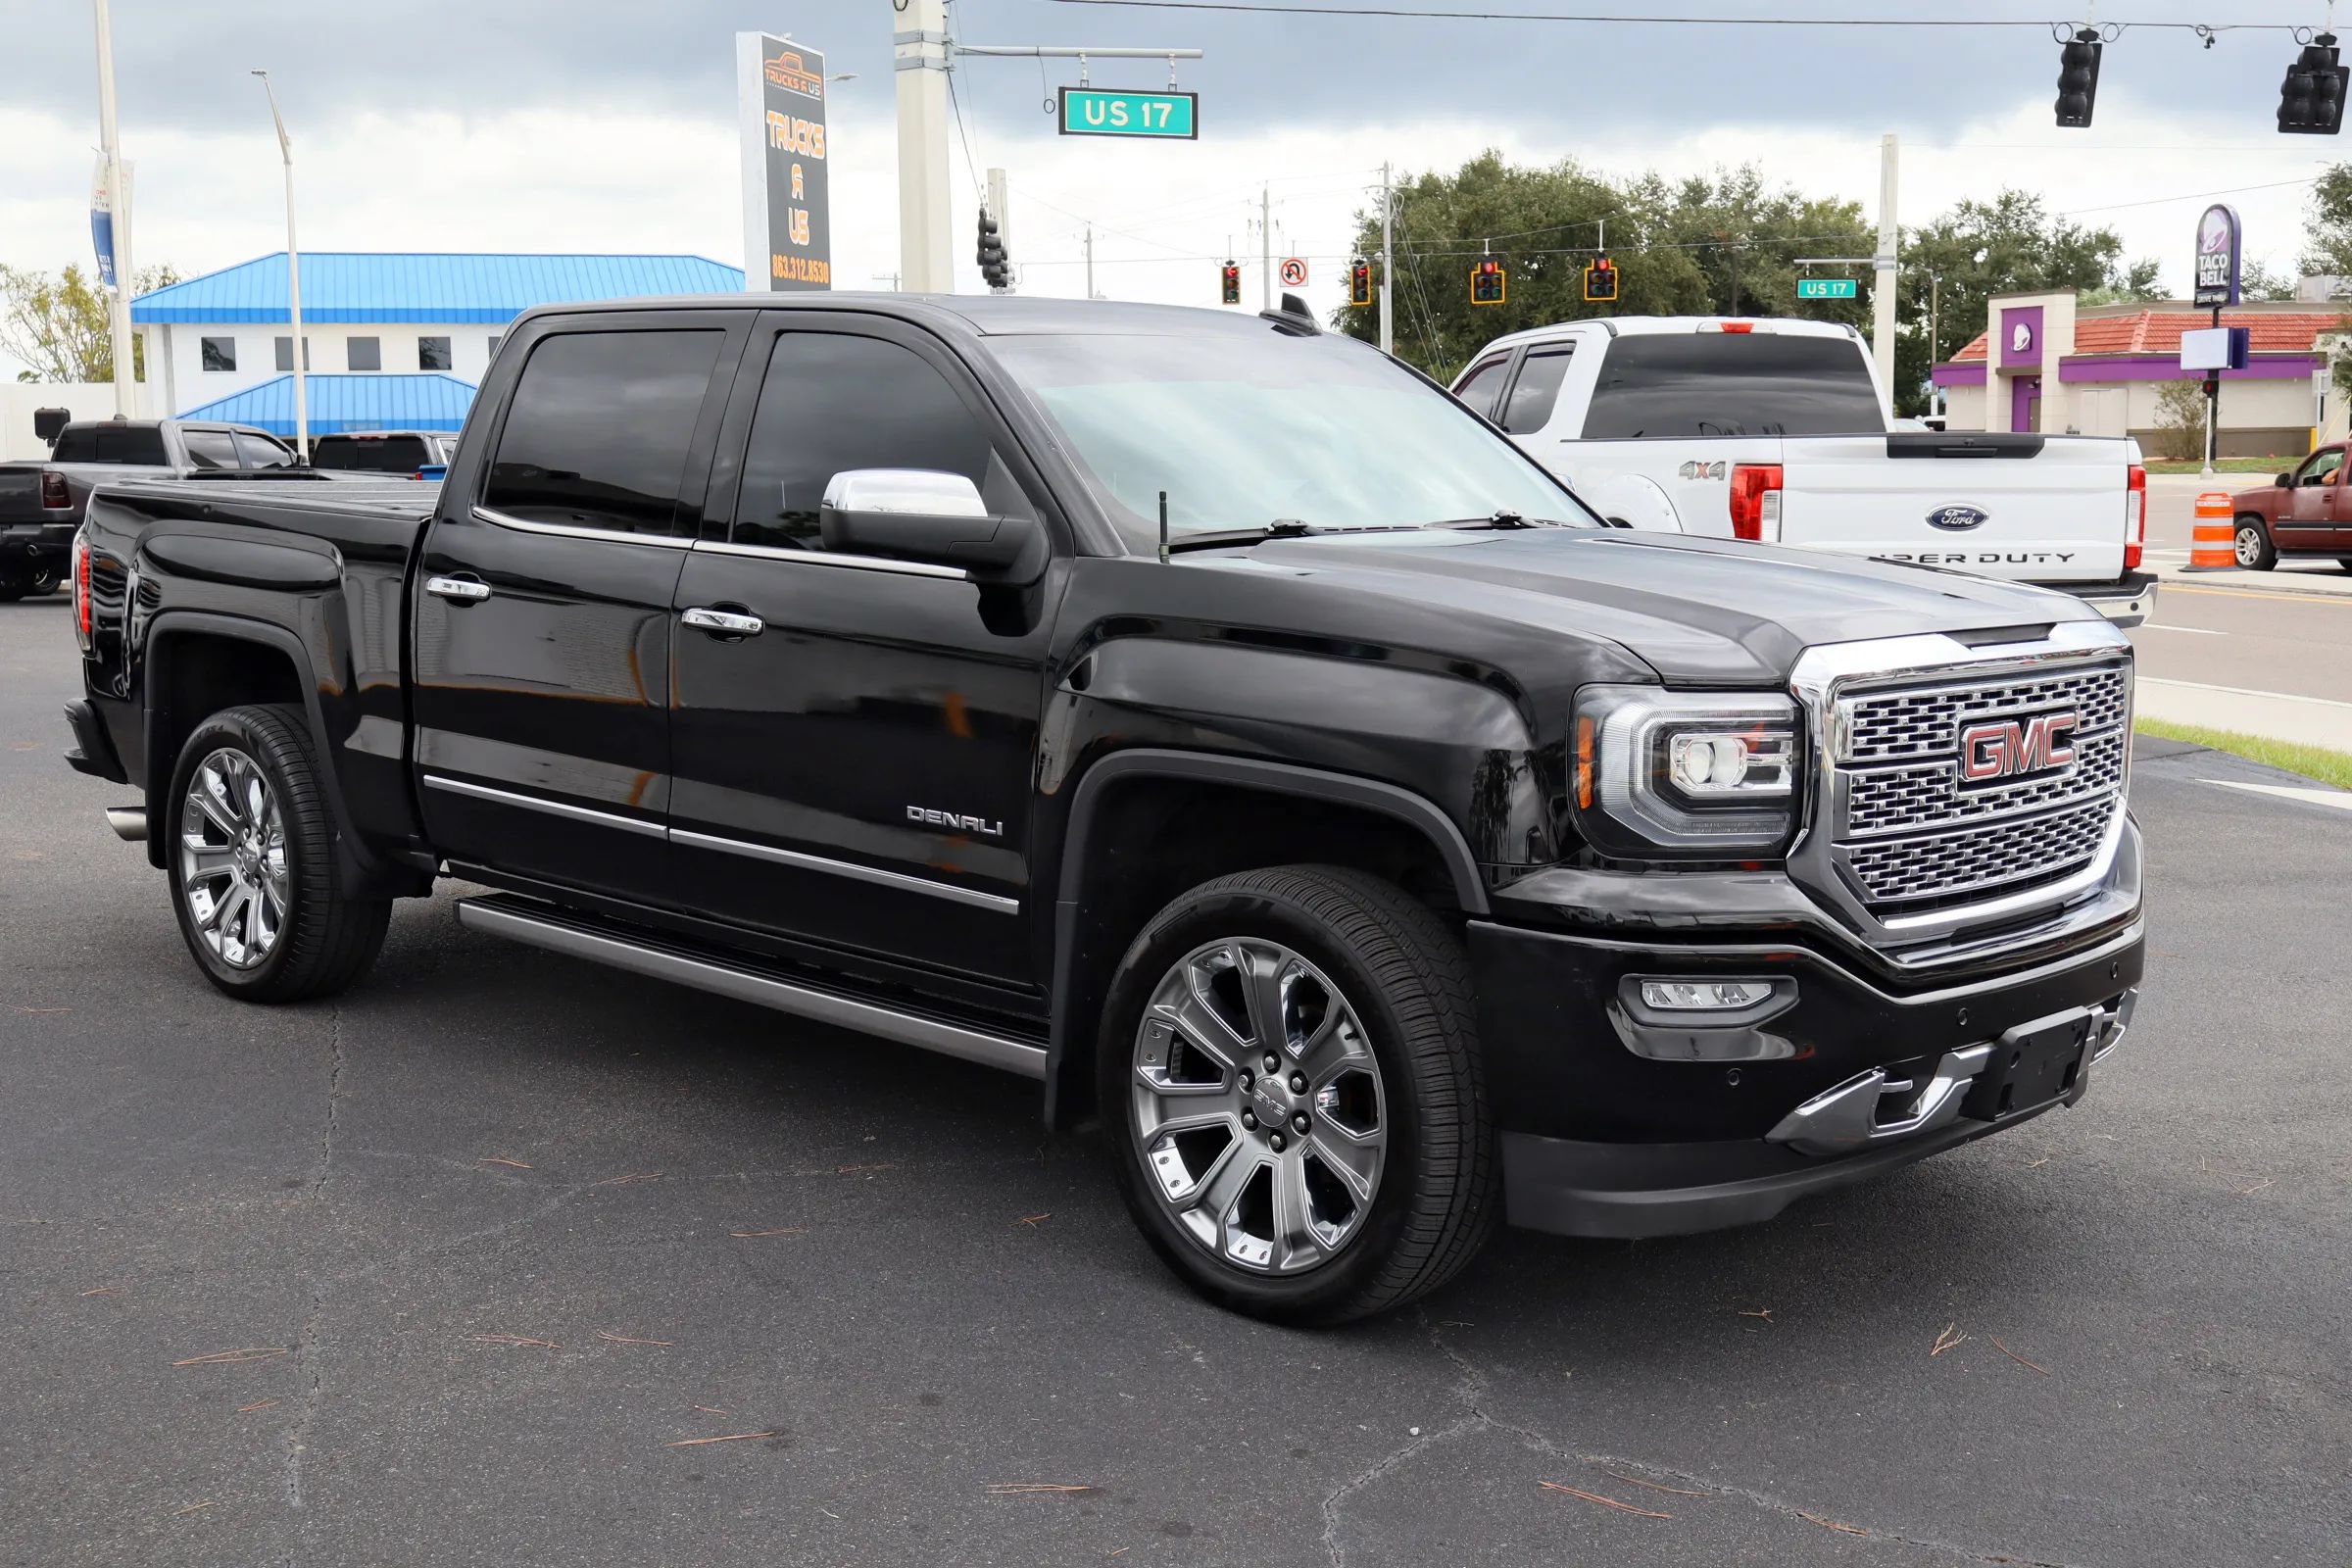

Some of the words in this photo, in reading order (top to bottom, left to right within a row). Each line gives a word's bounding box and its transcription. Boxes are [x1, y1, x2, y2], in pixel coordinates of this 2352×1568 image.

[765, 69, 799, 89] TRUCKS
[808, 82, 821, 96] US
[1085, 99, 1129, 126] US
[1141, 102, 1173, 128] 17
[766, 110, 825, 160] TRUCKS
[788, 207, 810, 246] US
[772, 254, 830, 284] 863.312.8530
[2198, 253, 2229, 270] TACO
[1806, 283, 1827, 295] US
[1833, 283, 1847, 295] 17
[2199, 270, 2227, 287] BELL
[1940, 509, 1976, 524] Ford
[1979, 554, 2076, 564] DUTY
[1963, 712, 2076, 782] GMC
[906, 806, 1004, 836] DENALI
